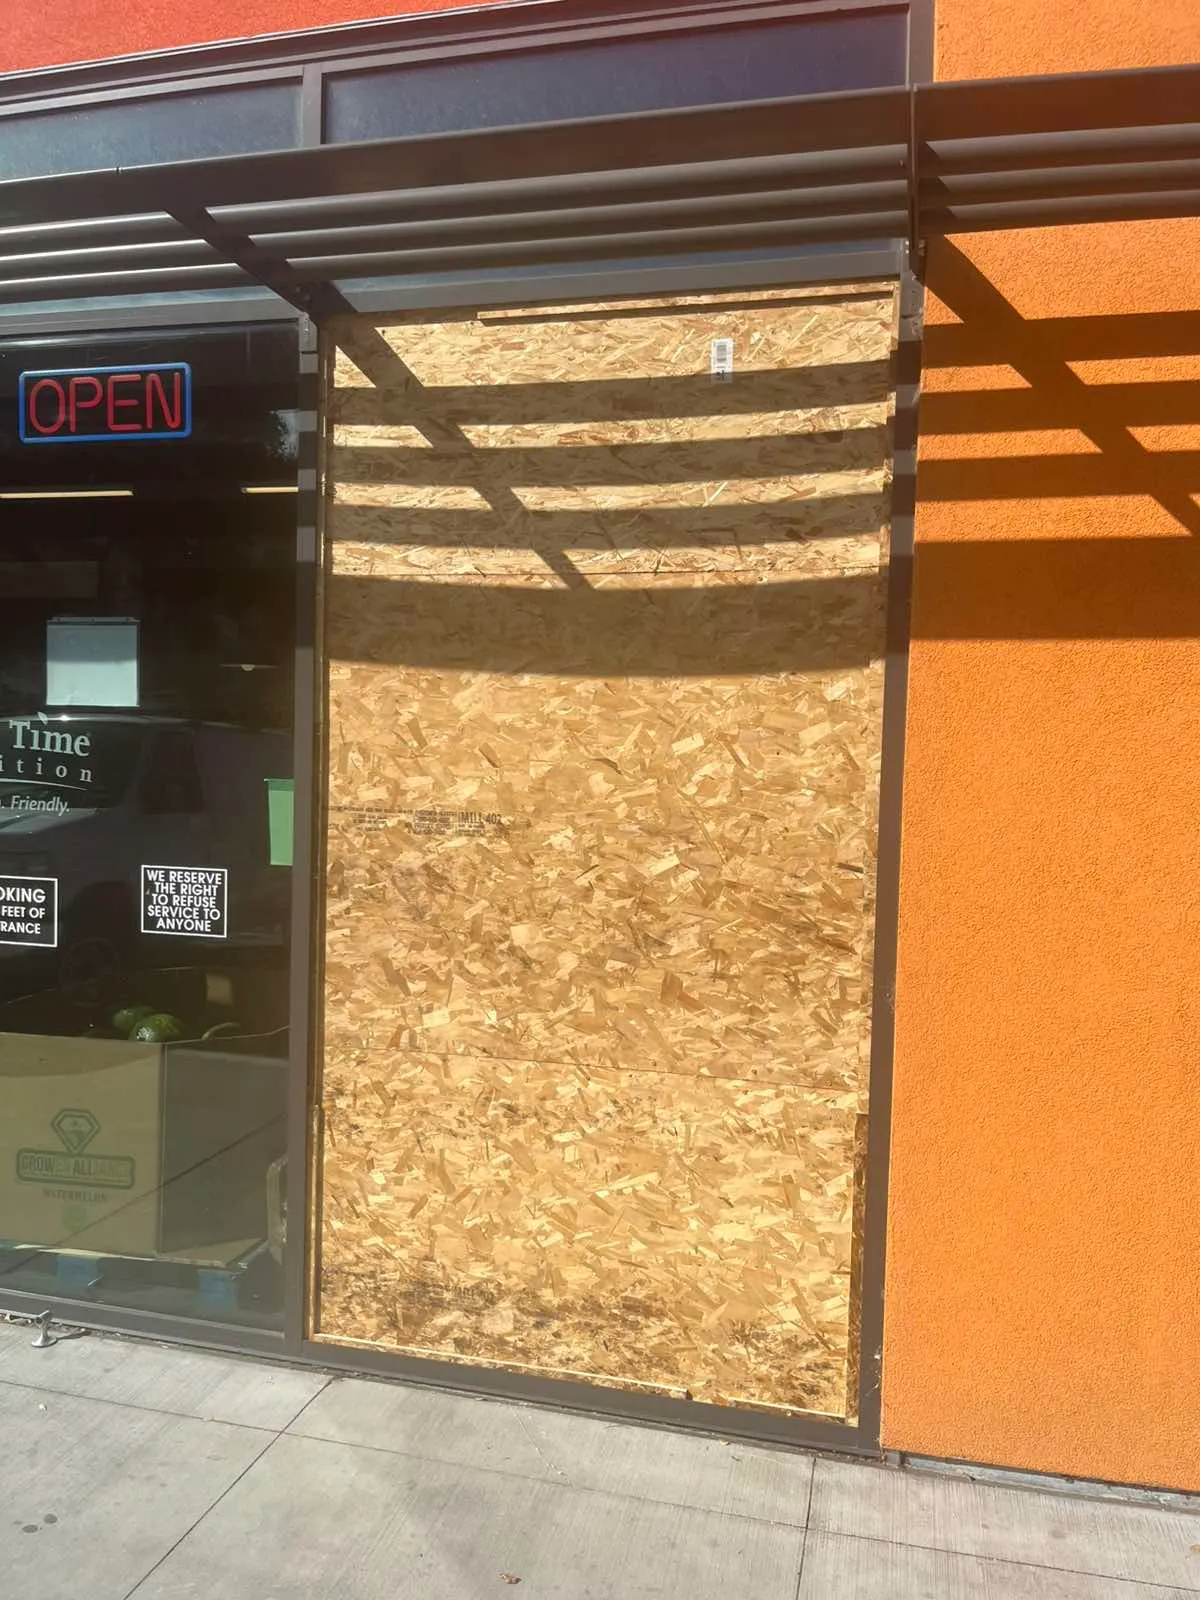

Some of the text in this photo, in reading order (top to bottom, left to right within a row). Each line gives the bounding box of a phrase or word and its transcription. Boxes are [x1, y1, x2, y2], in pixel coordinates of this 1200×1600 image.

[29, 372, 182, 434] OPEN
[9, 719, 91, 757] Time
[11, 795, 70, 816] Friendly.
[146, 869, 222, 885] WE RESERVE
[154, 881, 219, 897] THE RIGHT
[151, 893, 217, 909] TO REFUSE
[1, 905, 46, 919] FEET OF
[147, 905, 221, 921] SERVICE TO
[156, 917, 212, 932] ANYONE
